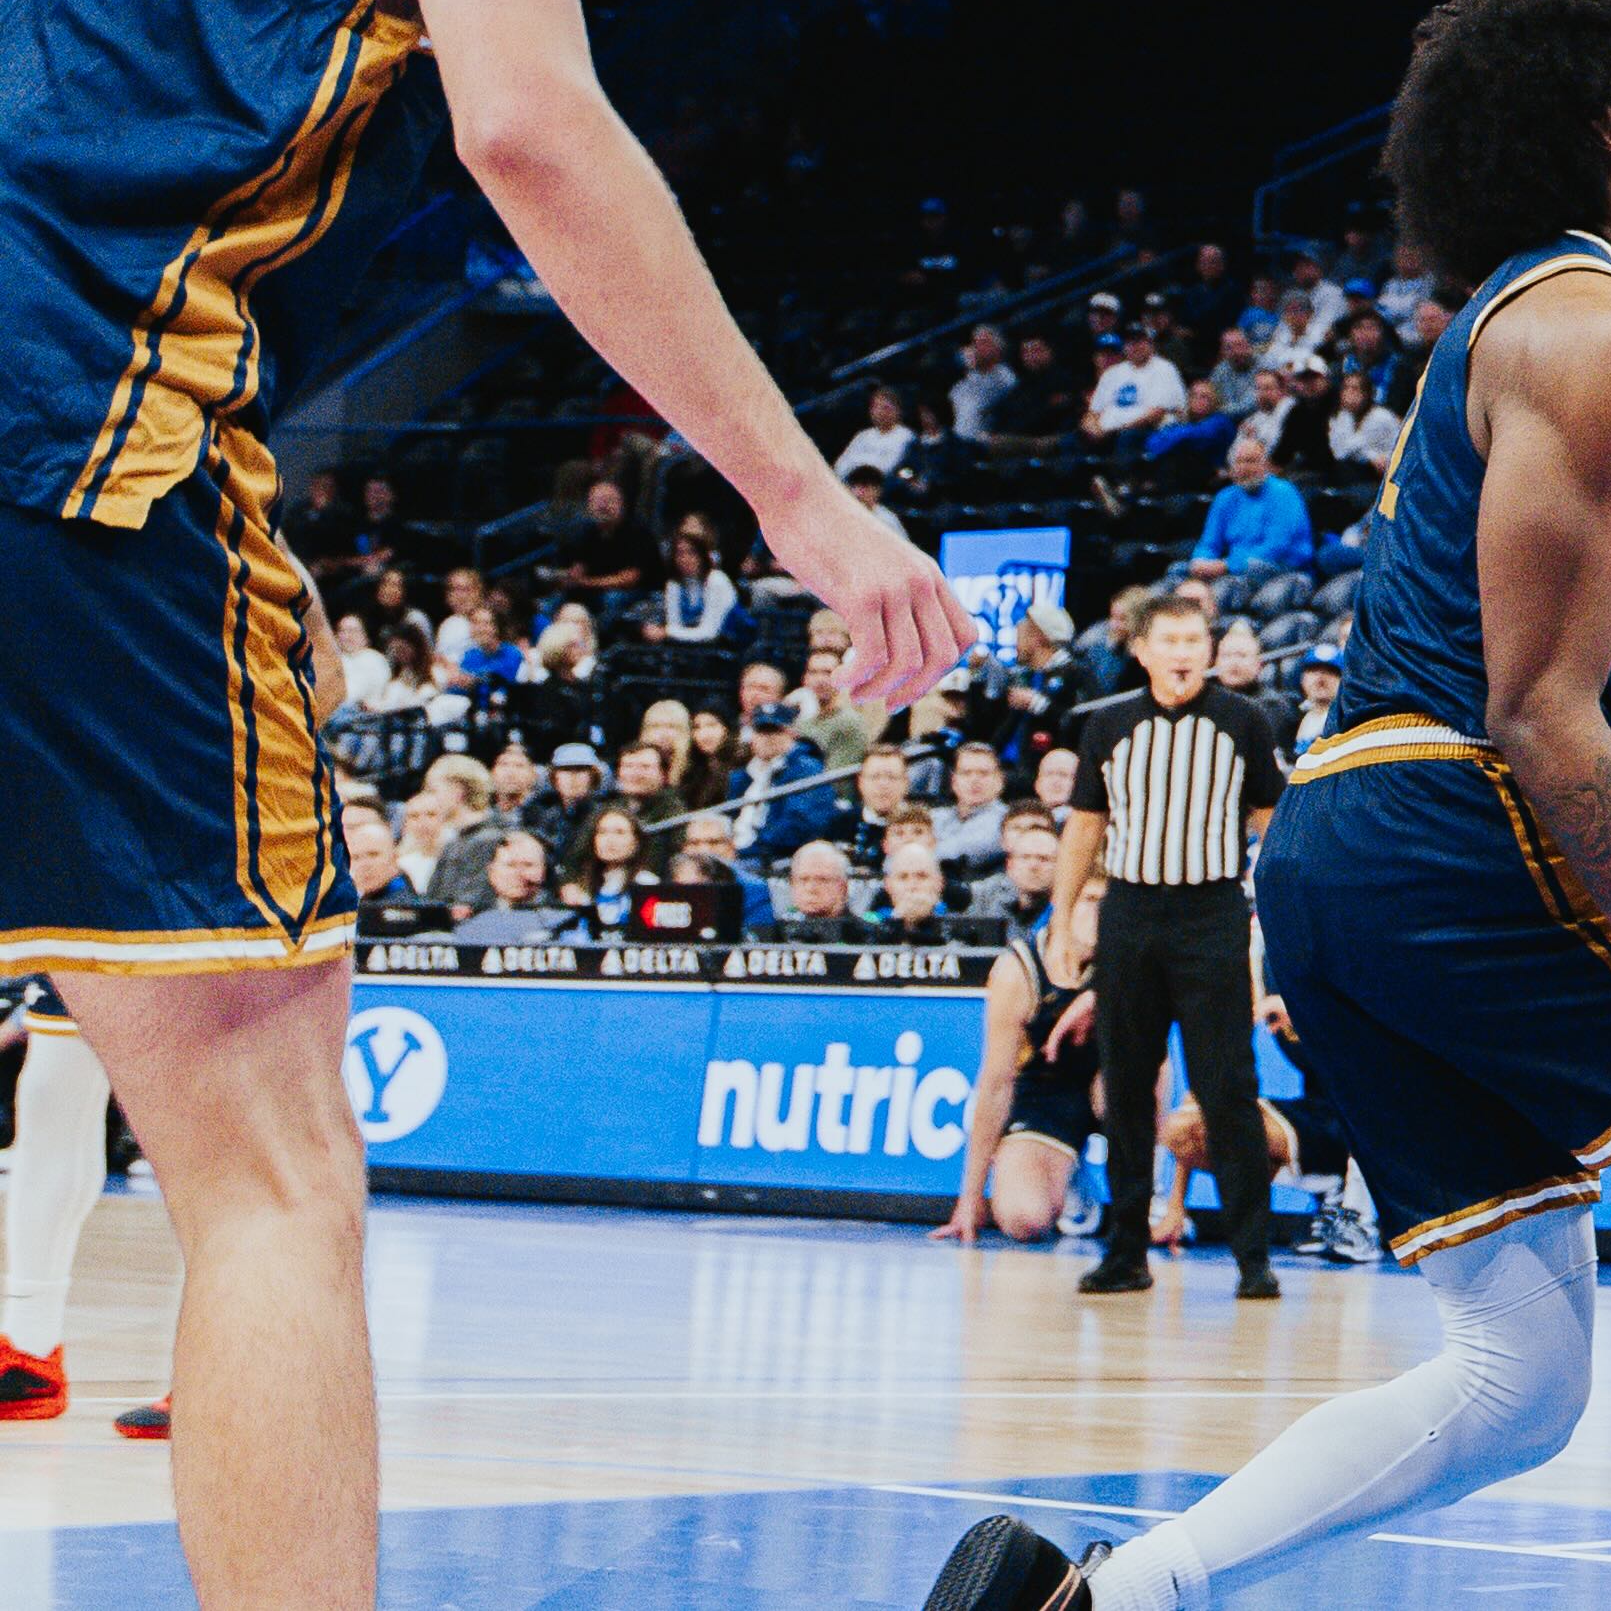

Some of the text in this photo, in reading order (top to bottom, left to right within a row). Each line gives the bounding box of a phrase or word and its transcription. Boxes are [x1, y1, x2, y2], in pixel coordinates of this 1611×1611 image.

[388, 944, 460, 971] DELTA
[503, 946, 578, 972] DELTA
[623, 947, 700, 974] DELTA
[747, 949, 828, 977] DELTA
[878, 951, 961, 979] DELTA
[350, 1026, 422, 1122] Y
[698, 1029, 972, 1159] nutric
